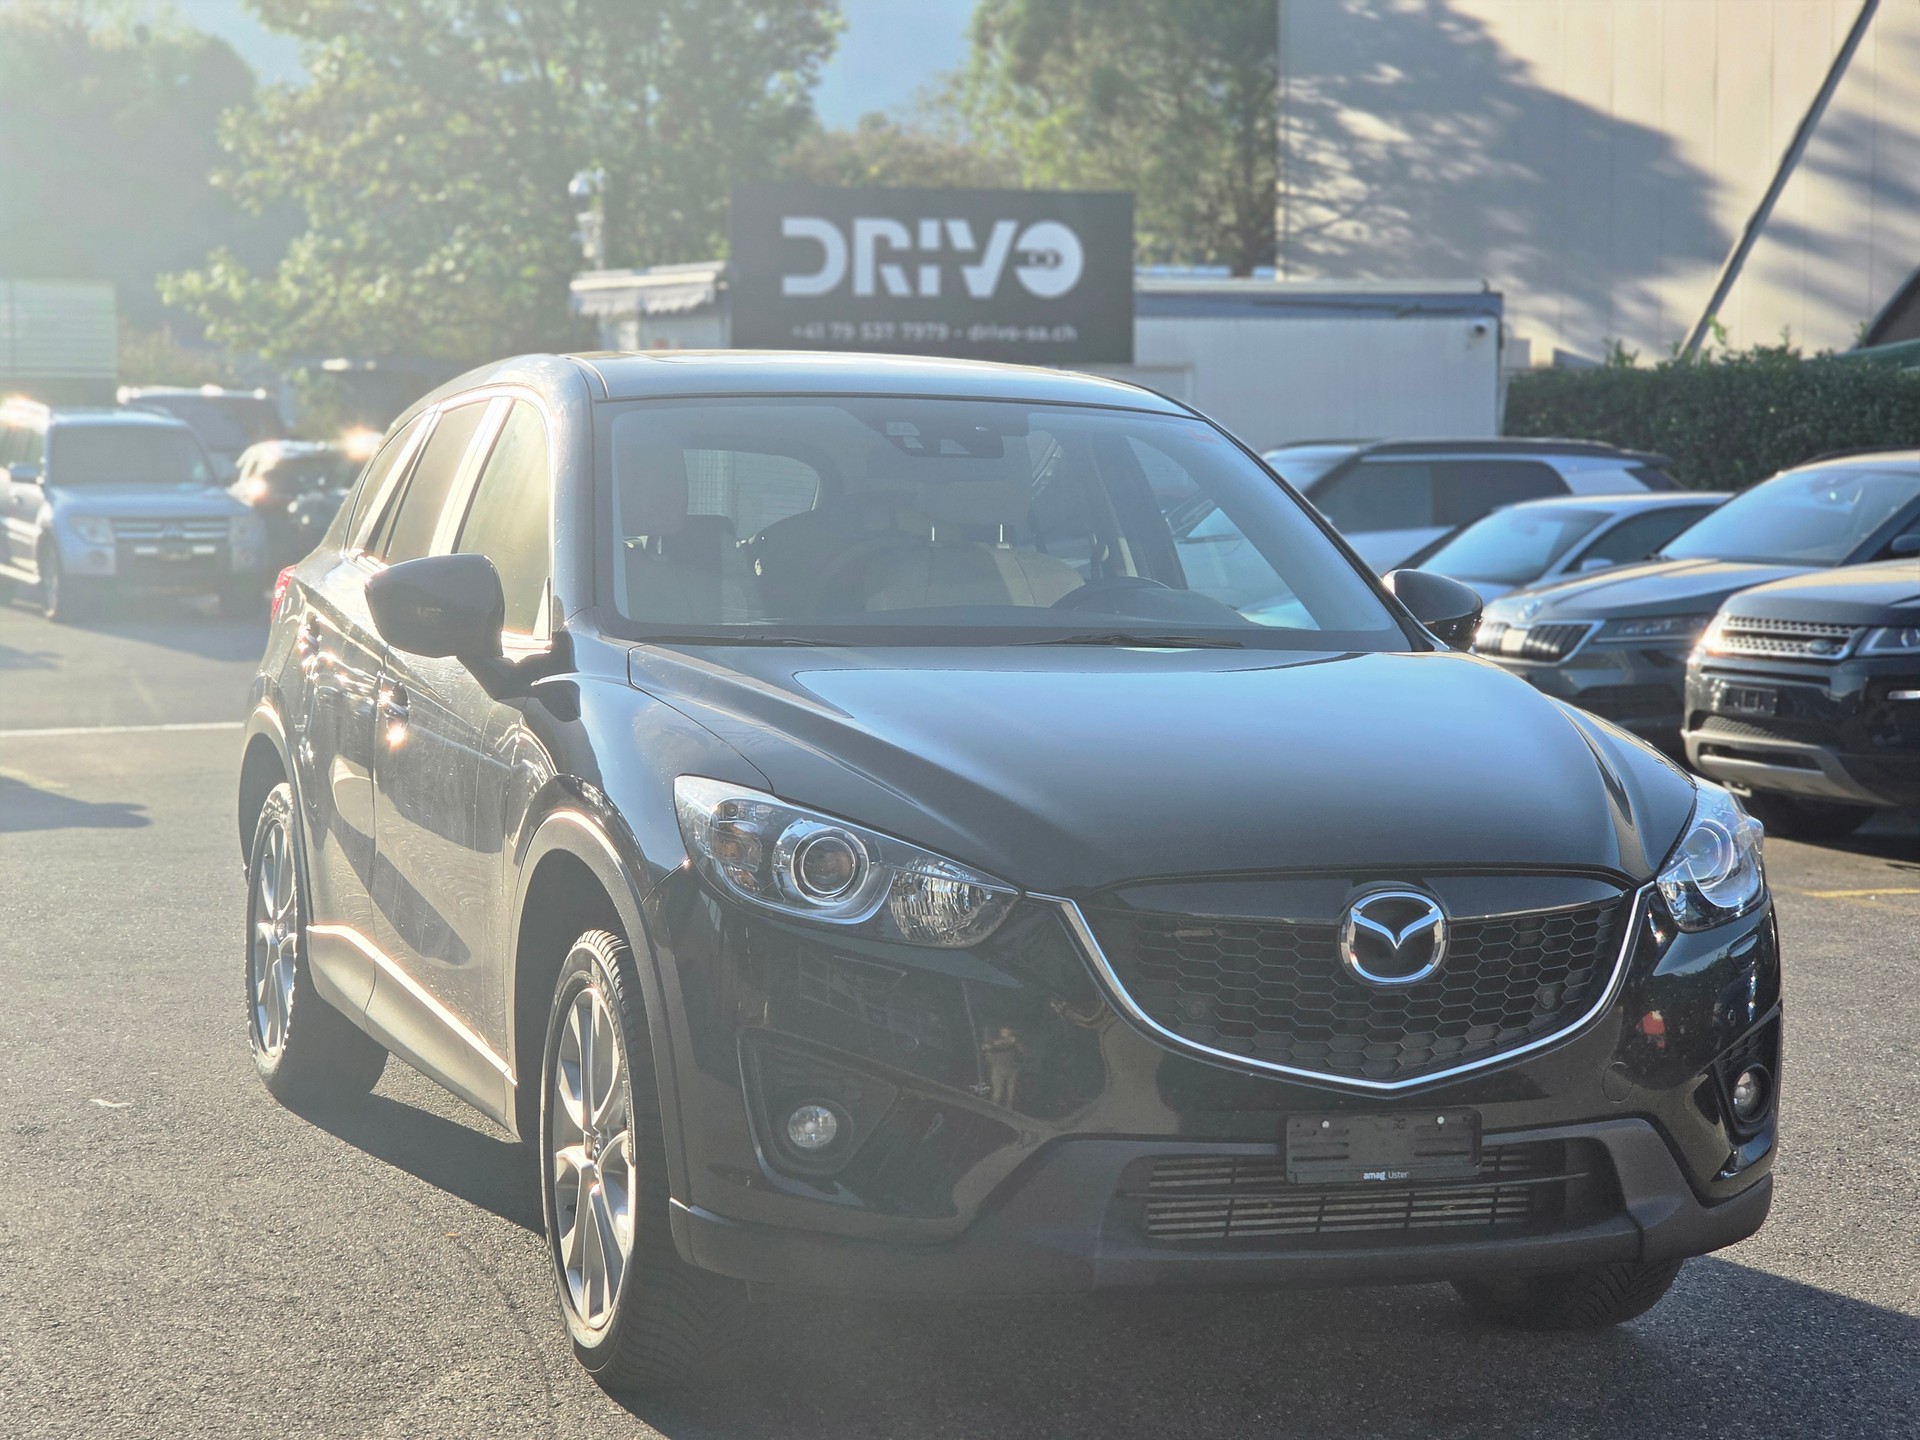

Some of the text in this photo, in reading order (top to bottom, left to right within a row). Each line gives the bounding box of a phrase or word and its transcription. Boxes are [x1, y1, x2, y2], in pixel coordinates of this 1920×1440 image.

[782, 217, 1084, 297] DRIVO
[792, 323, 825, 340] +41
[830, 322, 855, 340] 79
[1363, 1171, 1386, 1180] amag
